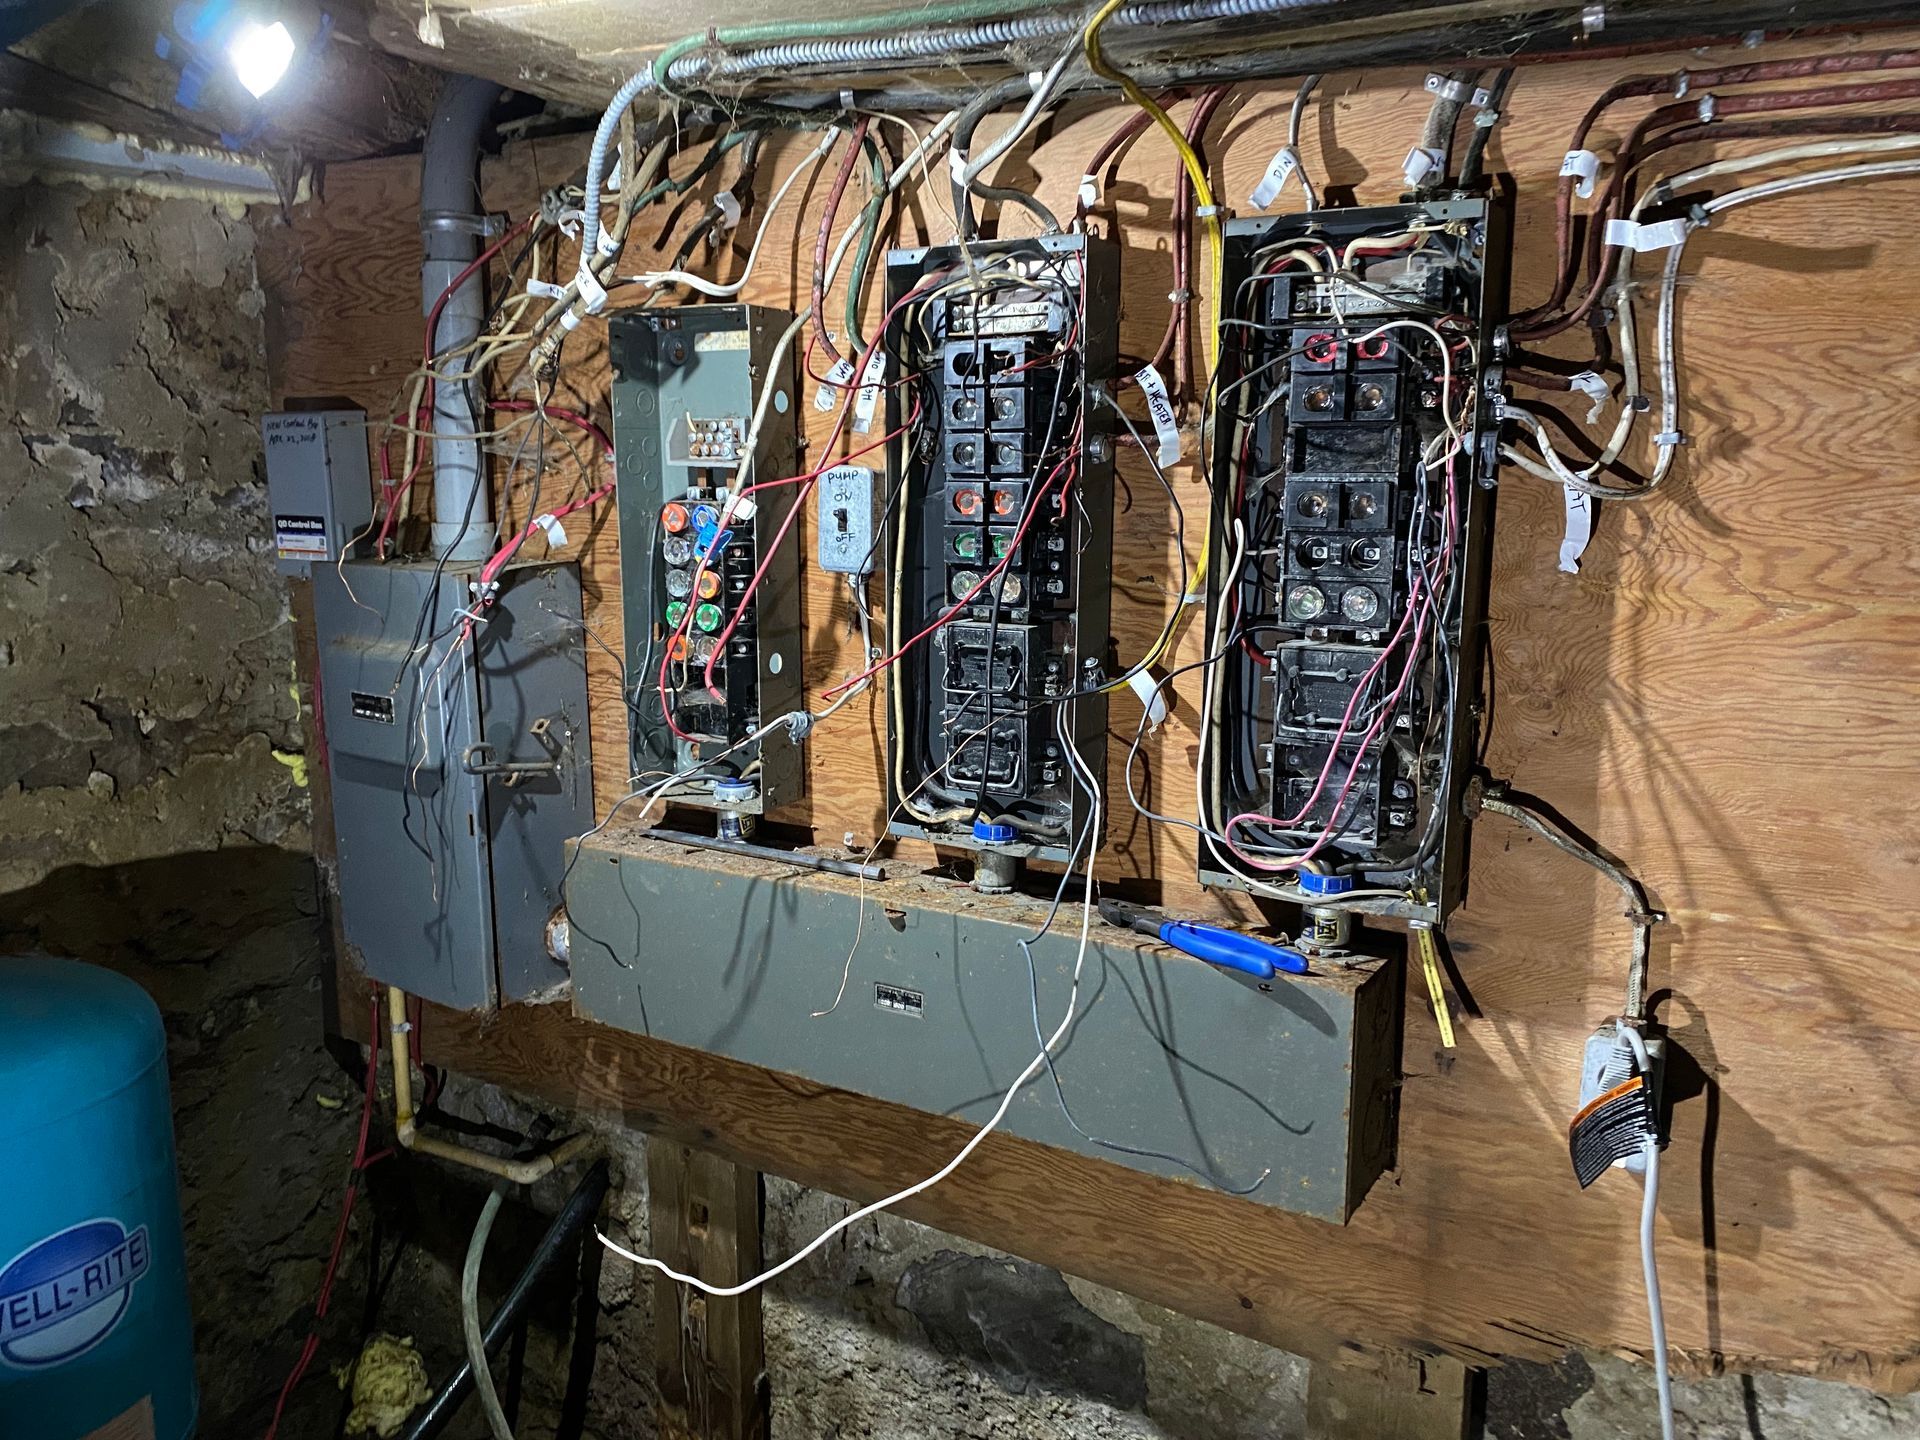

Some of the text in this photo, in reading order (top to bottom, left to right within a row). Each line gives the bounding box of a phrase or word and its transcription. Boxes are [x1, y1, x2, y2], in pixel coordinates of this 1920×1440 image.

[1273, 156, 1293, 179] DIN
[1149, 389, 1172, 425] HEATER
[827, 470, 859, 484] PUMP
[834, 491, 853, 502] ON
[288, 520, 310, 529] Control
[310, 521, 323, 530] Box
[0, 1236, 145, 1333] ELL-RITE
